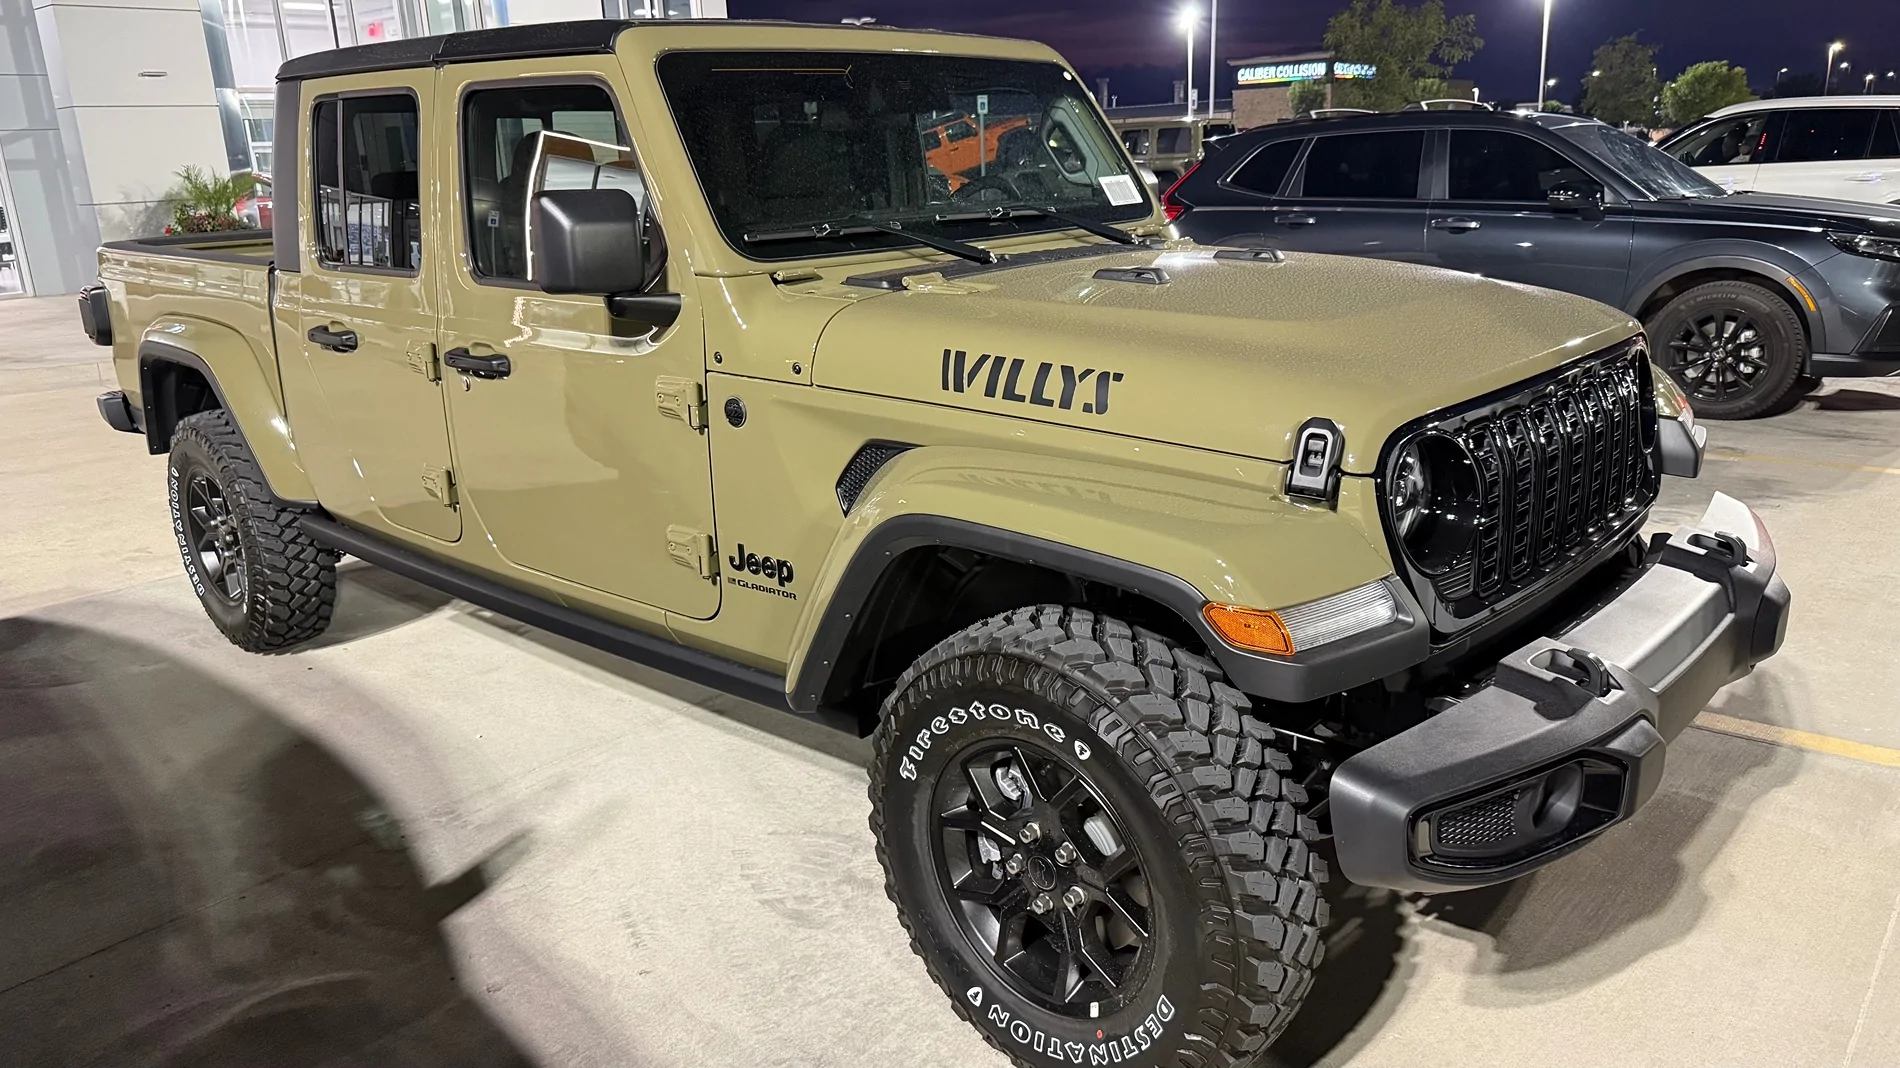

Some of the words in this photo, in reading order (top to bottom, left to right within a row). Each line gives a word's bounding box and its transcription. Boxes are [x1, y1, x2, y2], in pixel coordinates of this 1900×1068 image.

[1237, 66, 1276, 81] CALIBER
[1276, 62, 1326, 78] COLLISION
[1696, 293, 1738, 302] MICHELIN
[941, 348, 1125, 415] WILLYS
[728, 543, 794, 588] Jeep
[737, 579, 797, 601] GLADIATOR
[899, 700, 1066, 781] Firestone
[987, 994, 1175, 1066] DESTINATION
